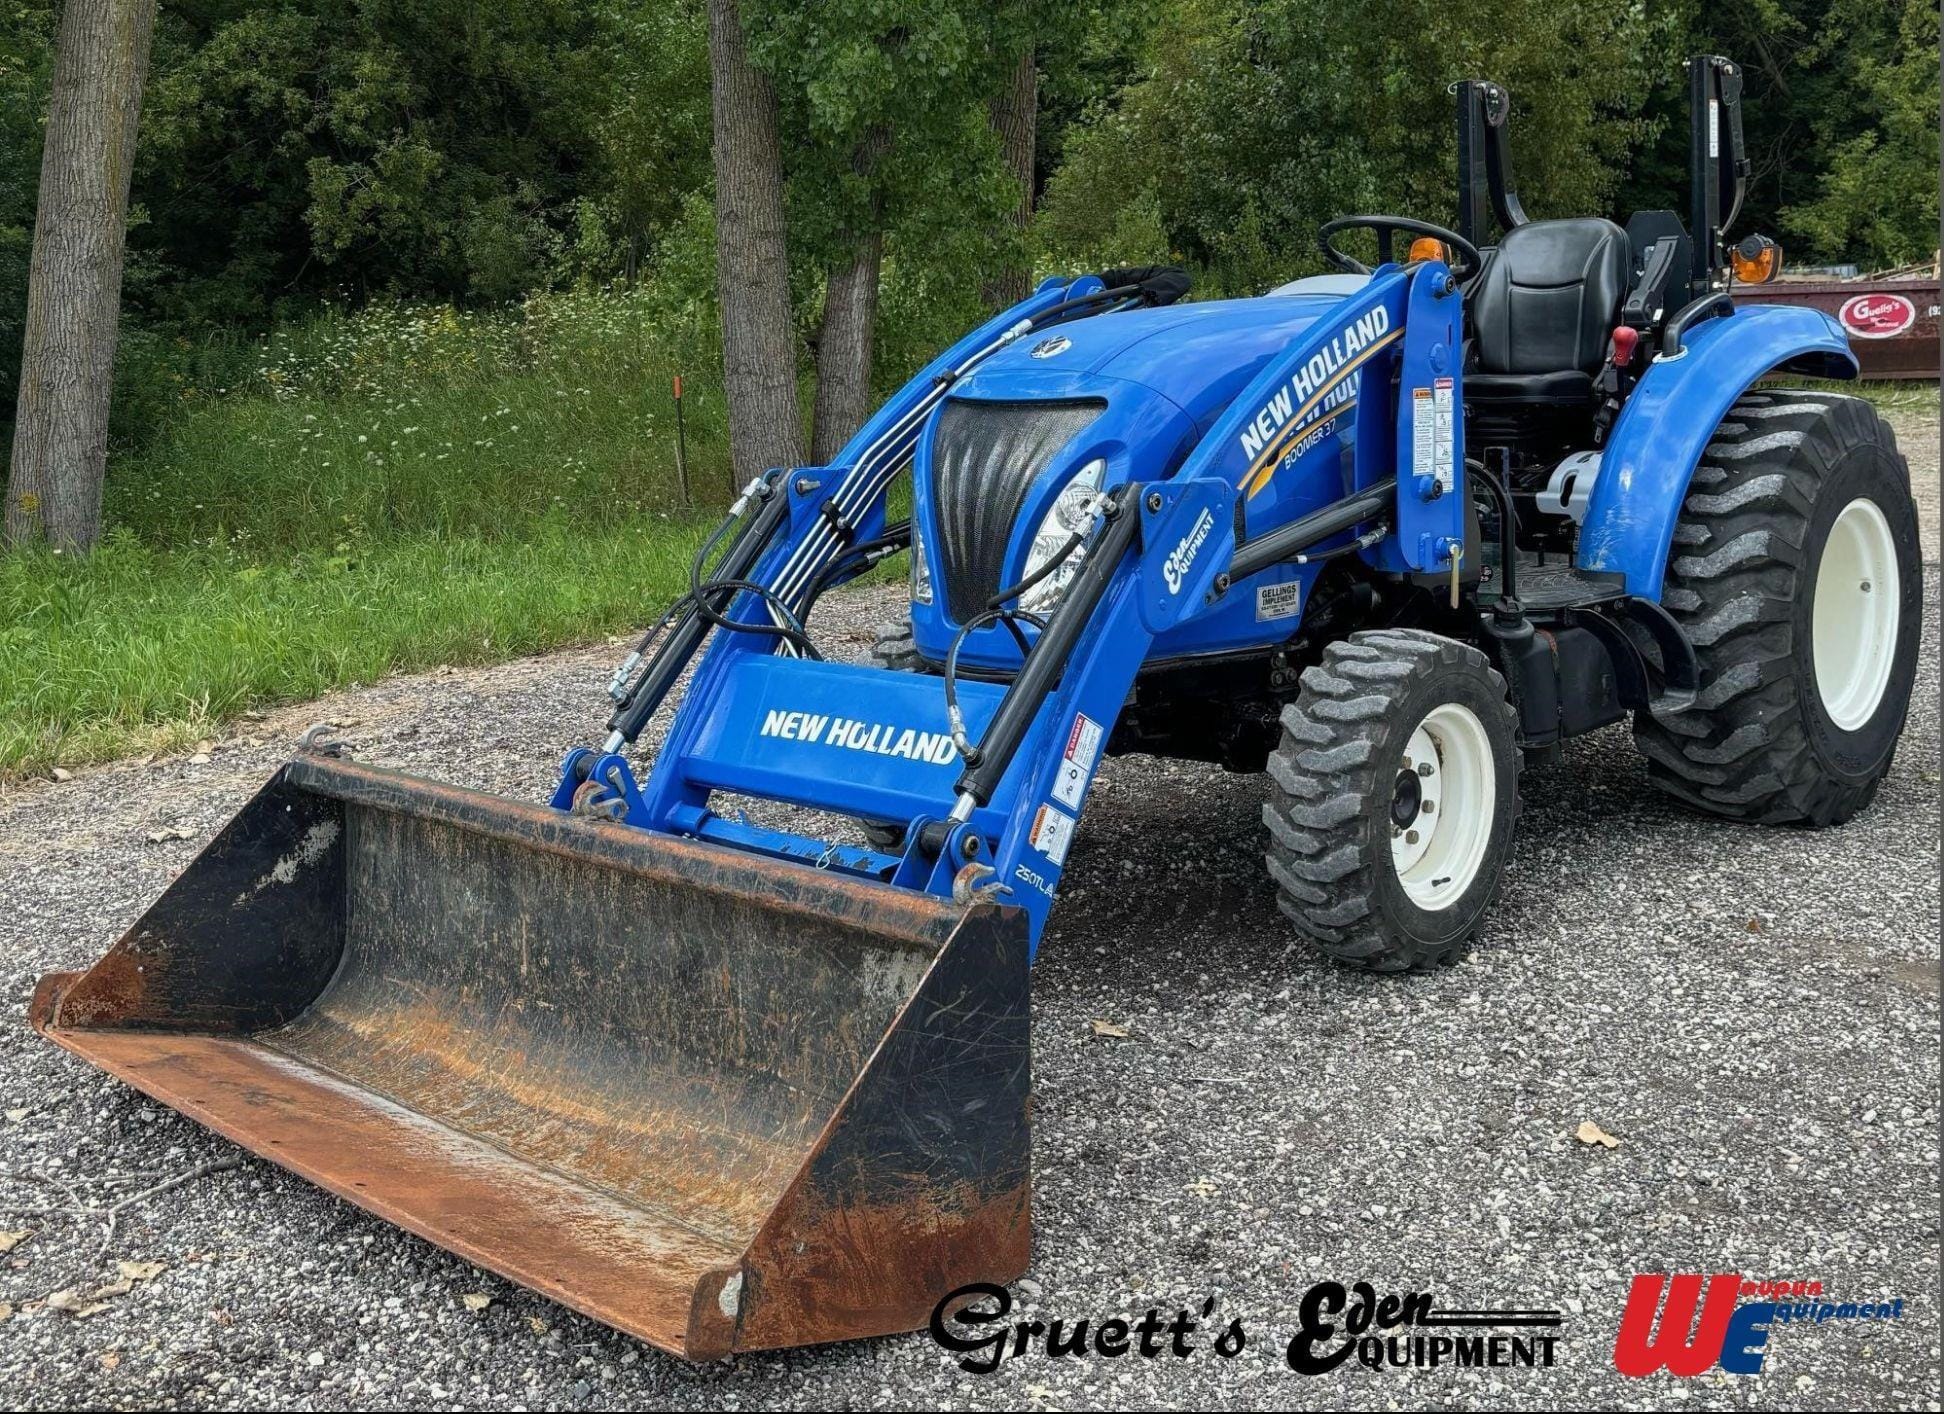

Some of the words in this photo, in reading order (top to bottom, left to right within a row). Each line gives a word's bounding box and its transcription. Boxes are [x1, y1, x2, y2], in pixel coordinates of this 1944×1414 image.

[1240, 385, 1294, 462] NEW
[1291, 304, 1390, 404] HOLLAND
[1284, 427, 1325, 471] BOOMER
[1325, 417, 1337, 437] 37
[1261, 584, 1297, 599] GELLINGS
[1262, 593, 1296, 607] IMPLEMENT
[760, 709, 830, 743] NEW
[825, 718, 958, 766] HOLLAND
[1070, 717, 1084, 752] DANGER
[1015, 863, 1054, 897] 250TLA
